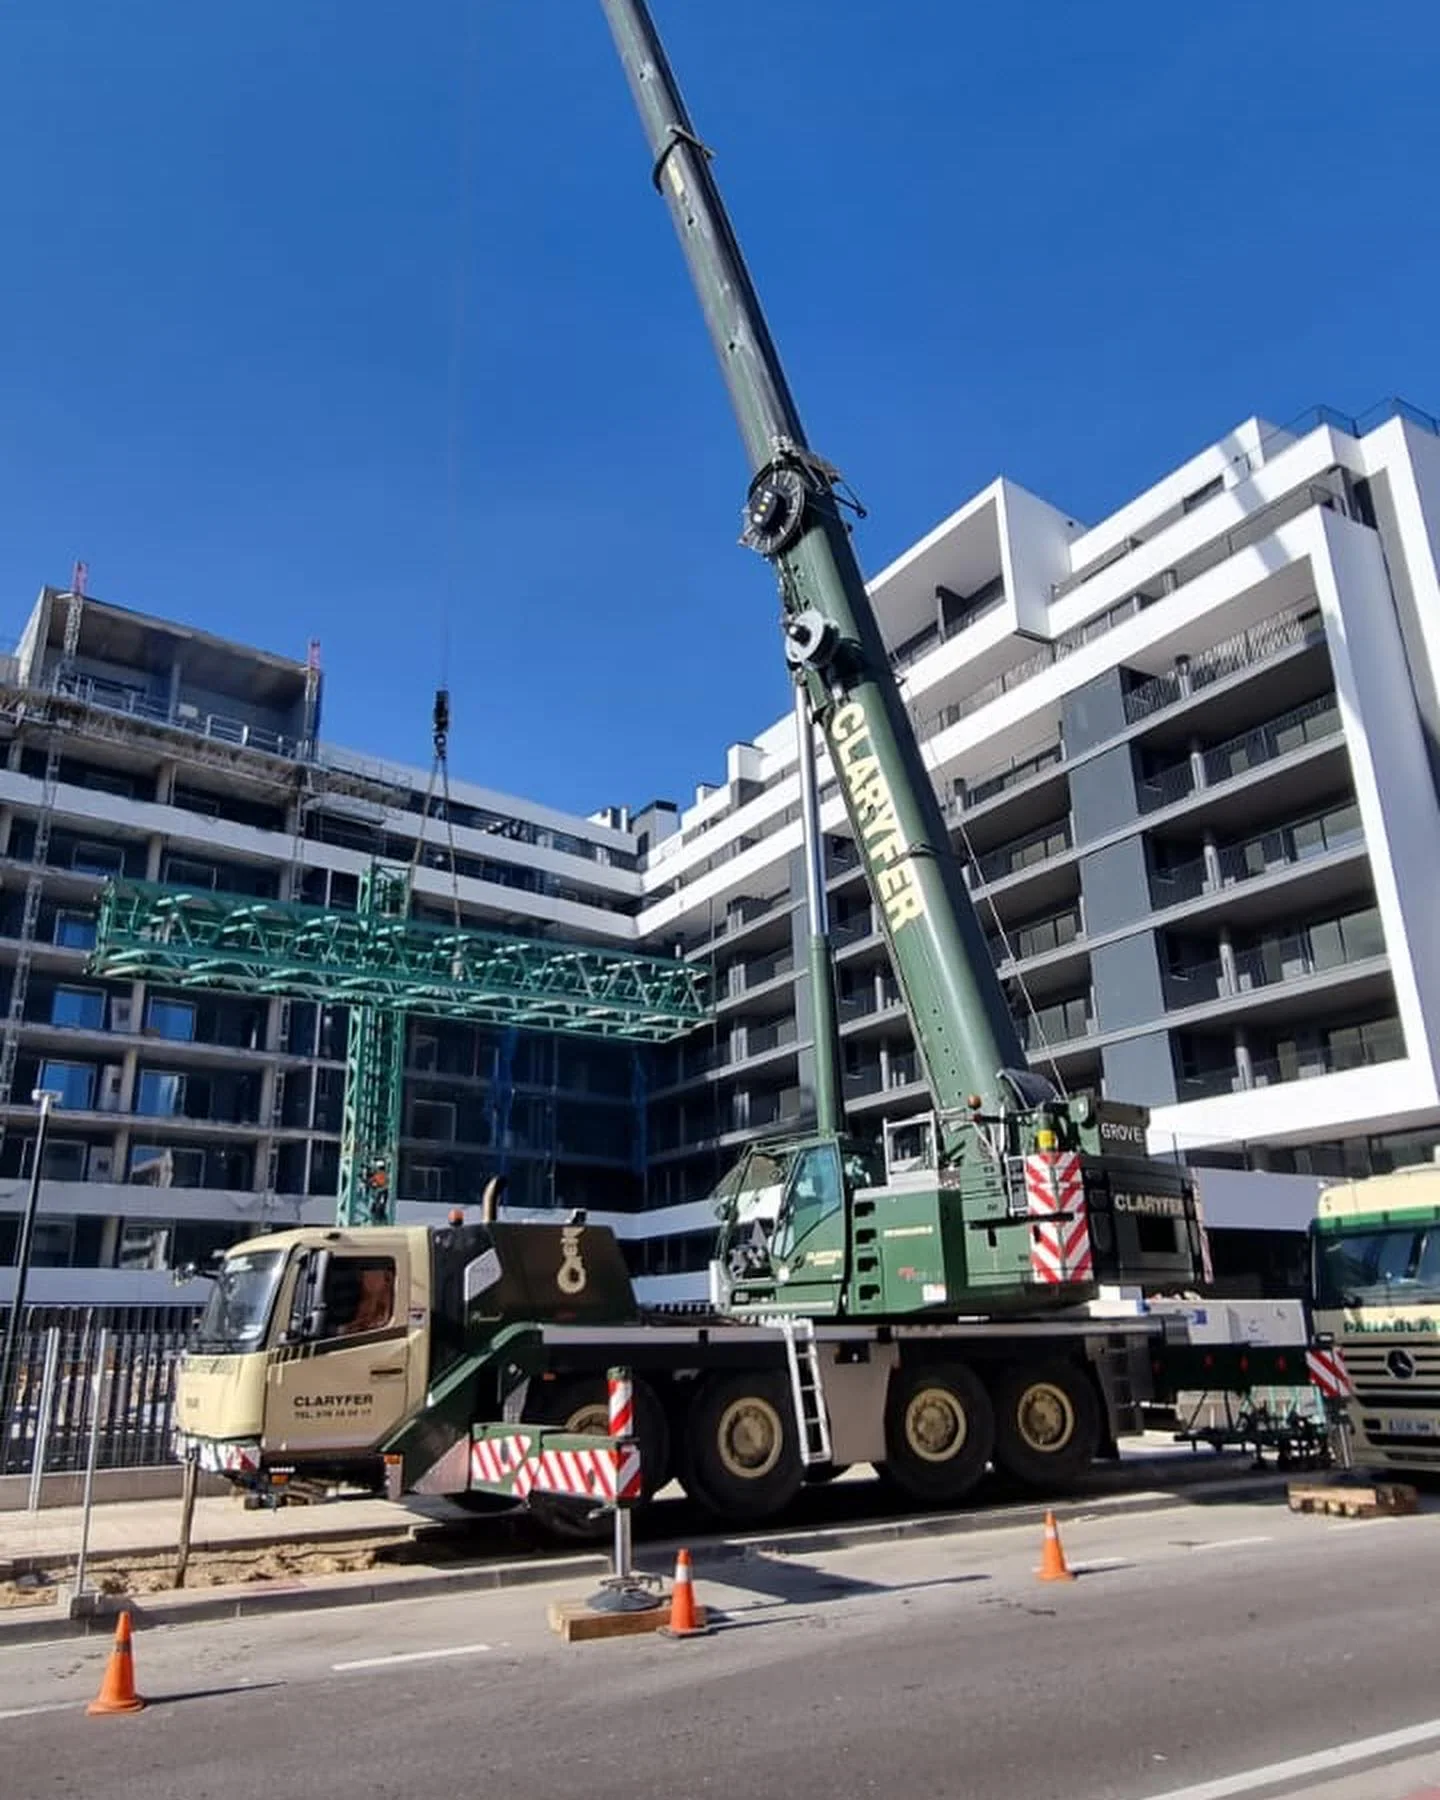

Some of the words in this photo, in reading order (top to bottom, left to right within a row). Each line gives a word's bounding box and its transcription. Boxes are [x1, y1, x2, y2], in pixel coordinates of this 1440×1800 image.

[831, 702, 925, 933] CLARYFER
[1101, 1122, 1144, 1144] GROVE
[293, 1393, 373, 1407] CLARYFER
